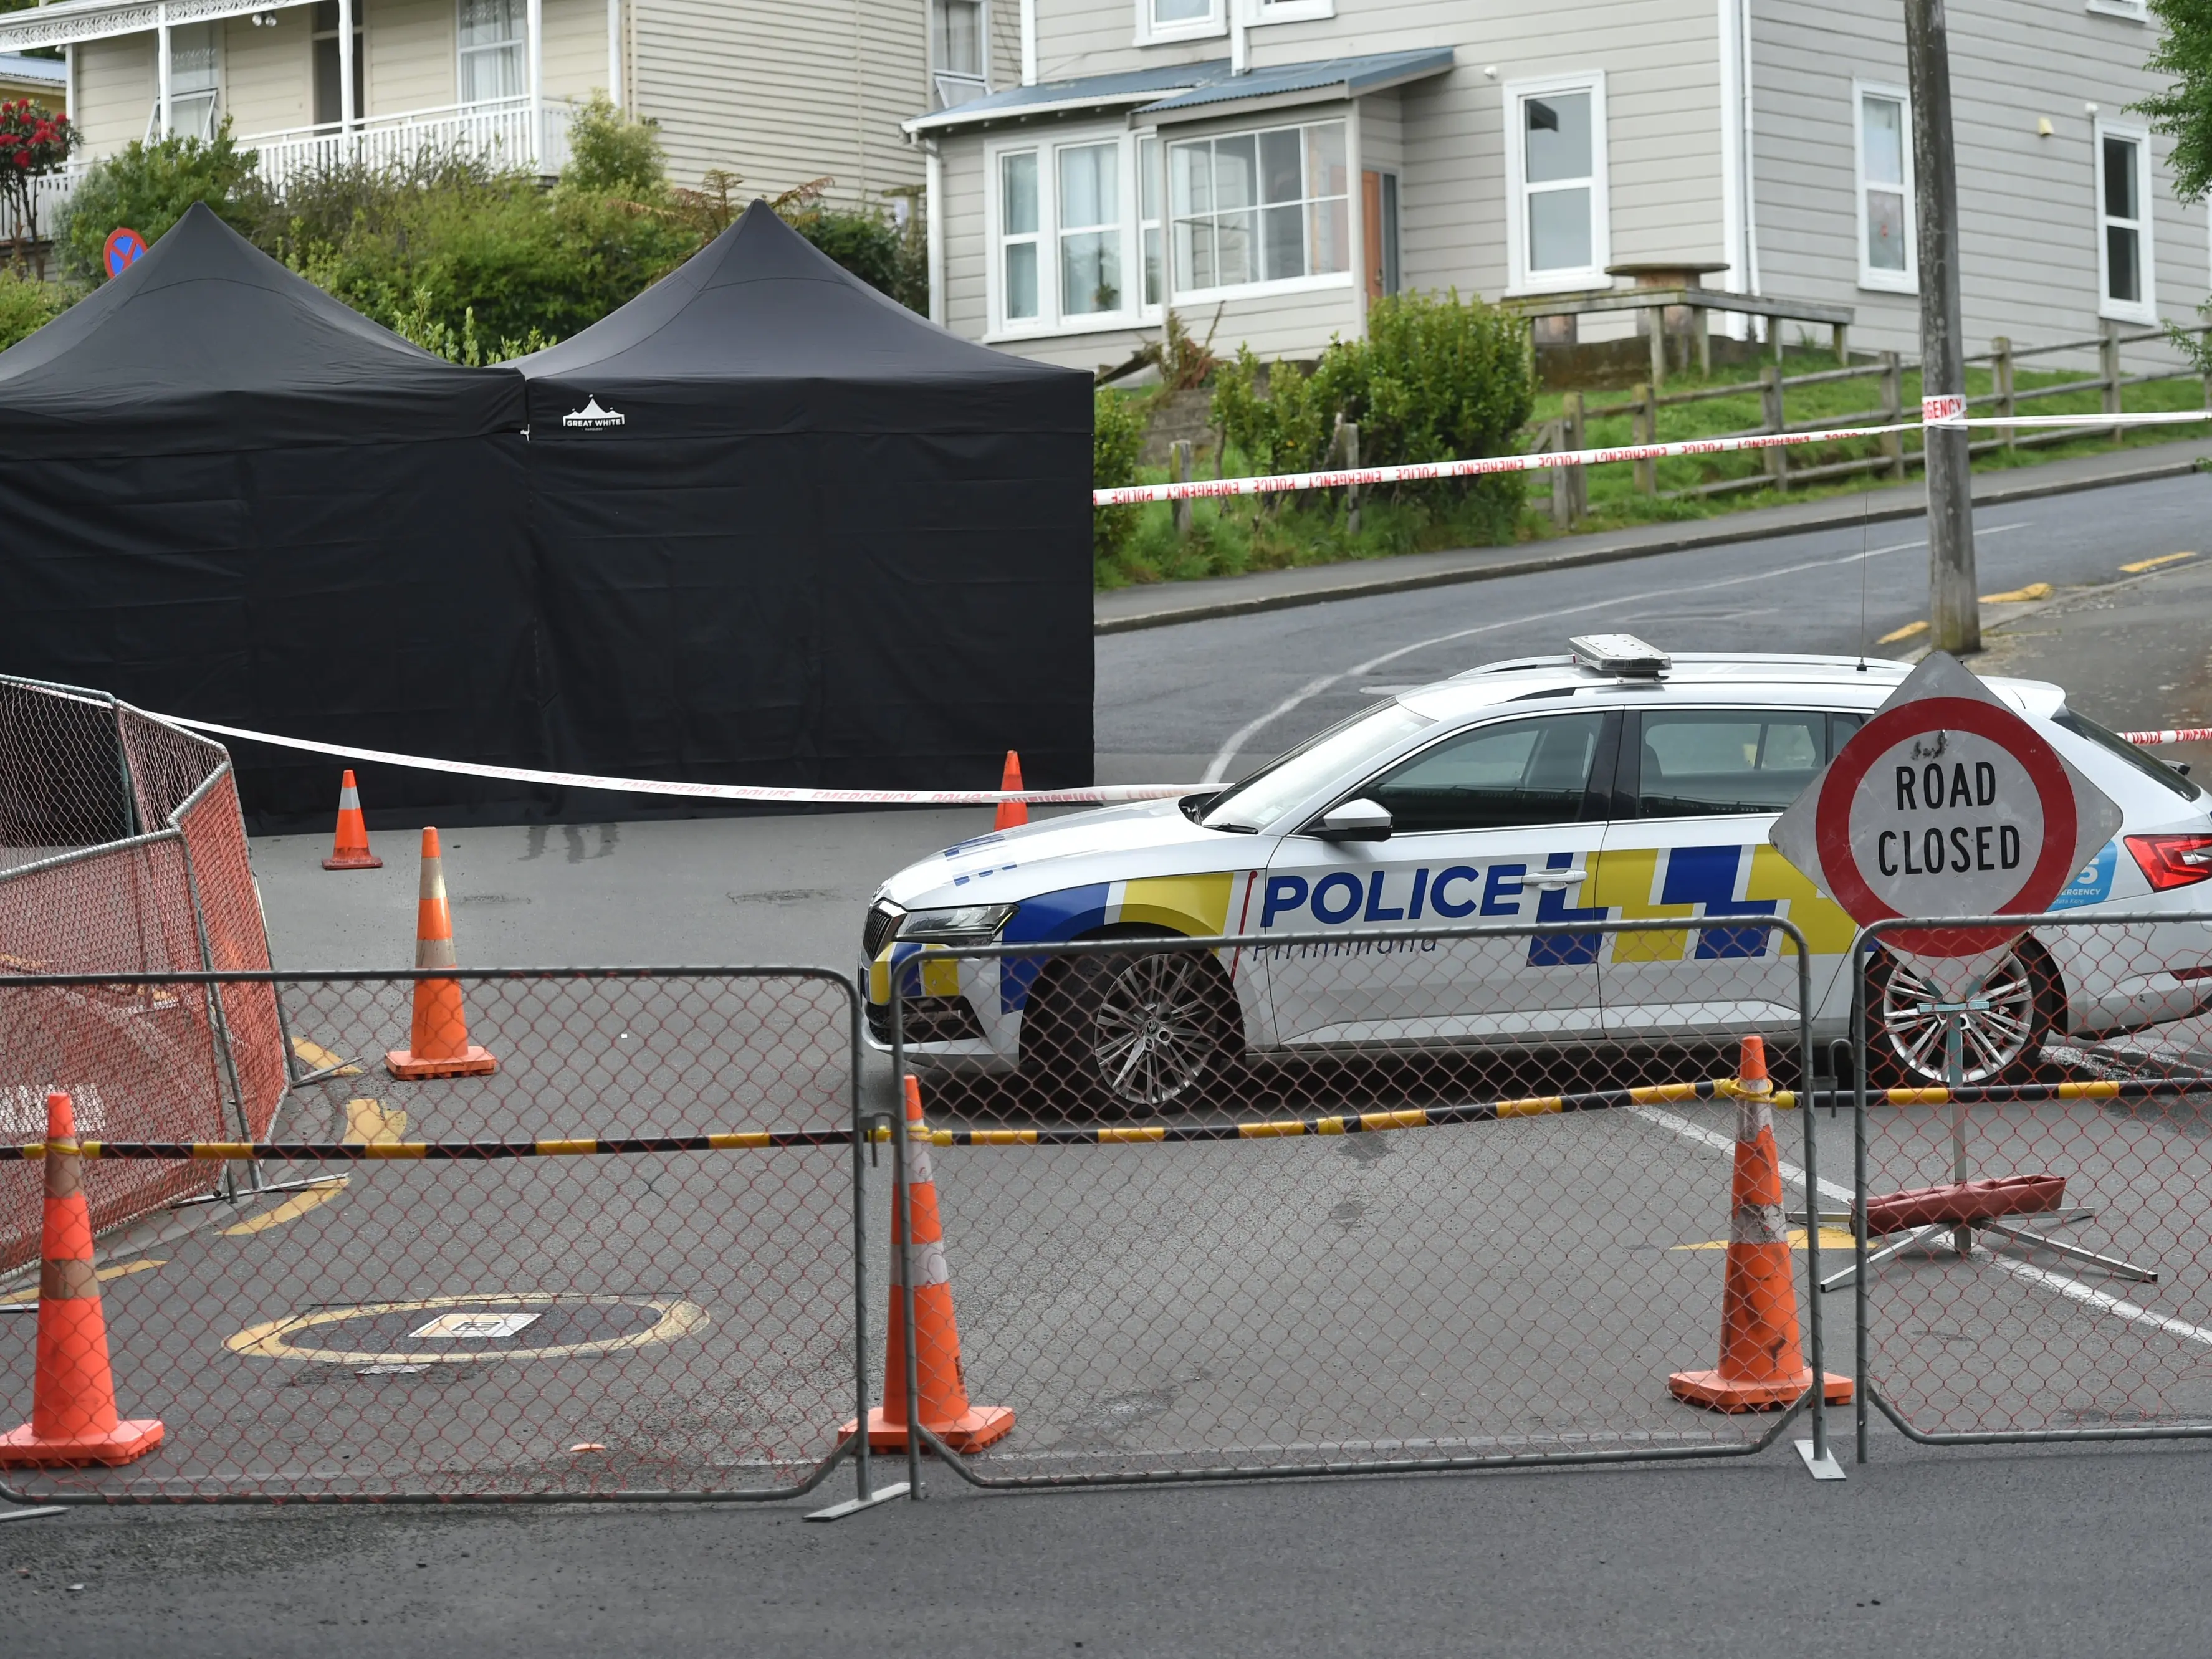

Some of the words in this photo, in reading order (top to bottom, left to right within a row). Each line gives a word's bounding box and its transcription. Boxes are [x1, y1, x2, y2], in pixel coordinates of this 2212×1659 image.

[595, 418, 621, 426] WHITE
[1538, 454, 1581, 467] POLICE
[1594, 447, 1667, 463] EMERGENCY
[1396, 466, 1439, 480] POLICE
[1452, 459, 1525, 476] EMERGENCY
[1253, 478, 1295, 492] POLICE
[1308, 471, 1382, 488] EMERGENCY
[1111, 488, 1153, 504] POLICE
[1166, 482, 1239, 500] EMERGENCY
[1896, 762, 1996, 810] ROAD
[810, 791, 917, 801] EMERGENCY
[1878, 825, 2021, 877] CLOSED
[1260, 864, 1527, 928] POLICE
